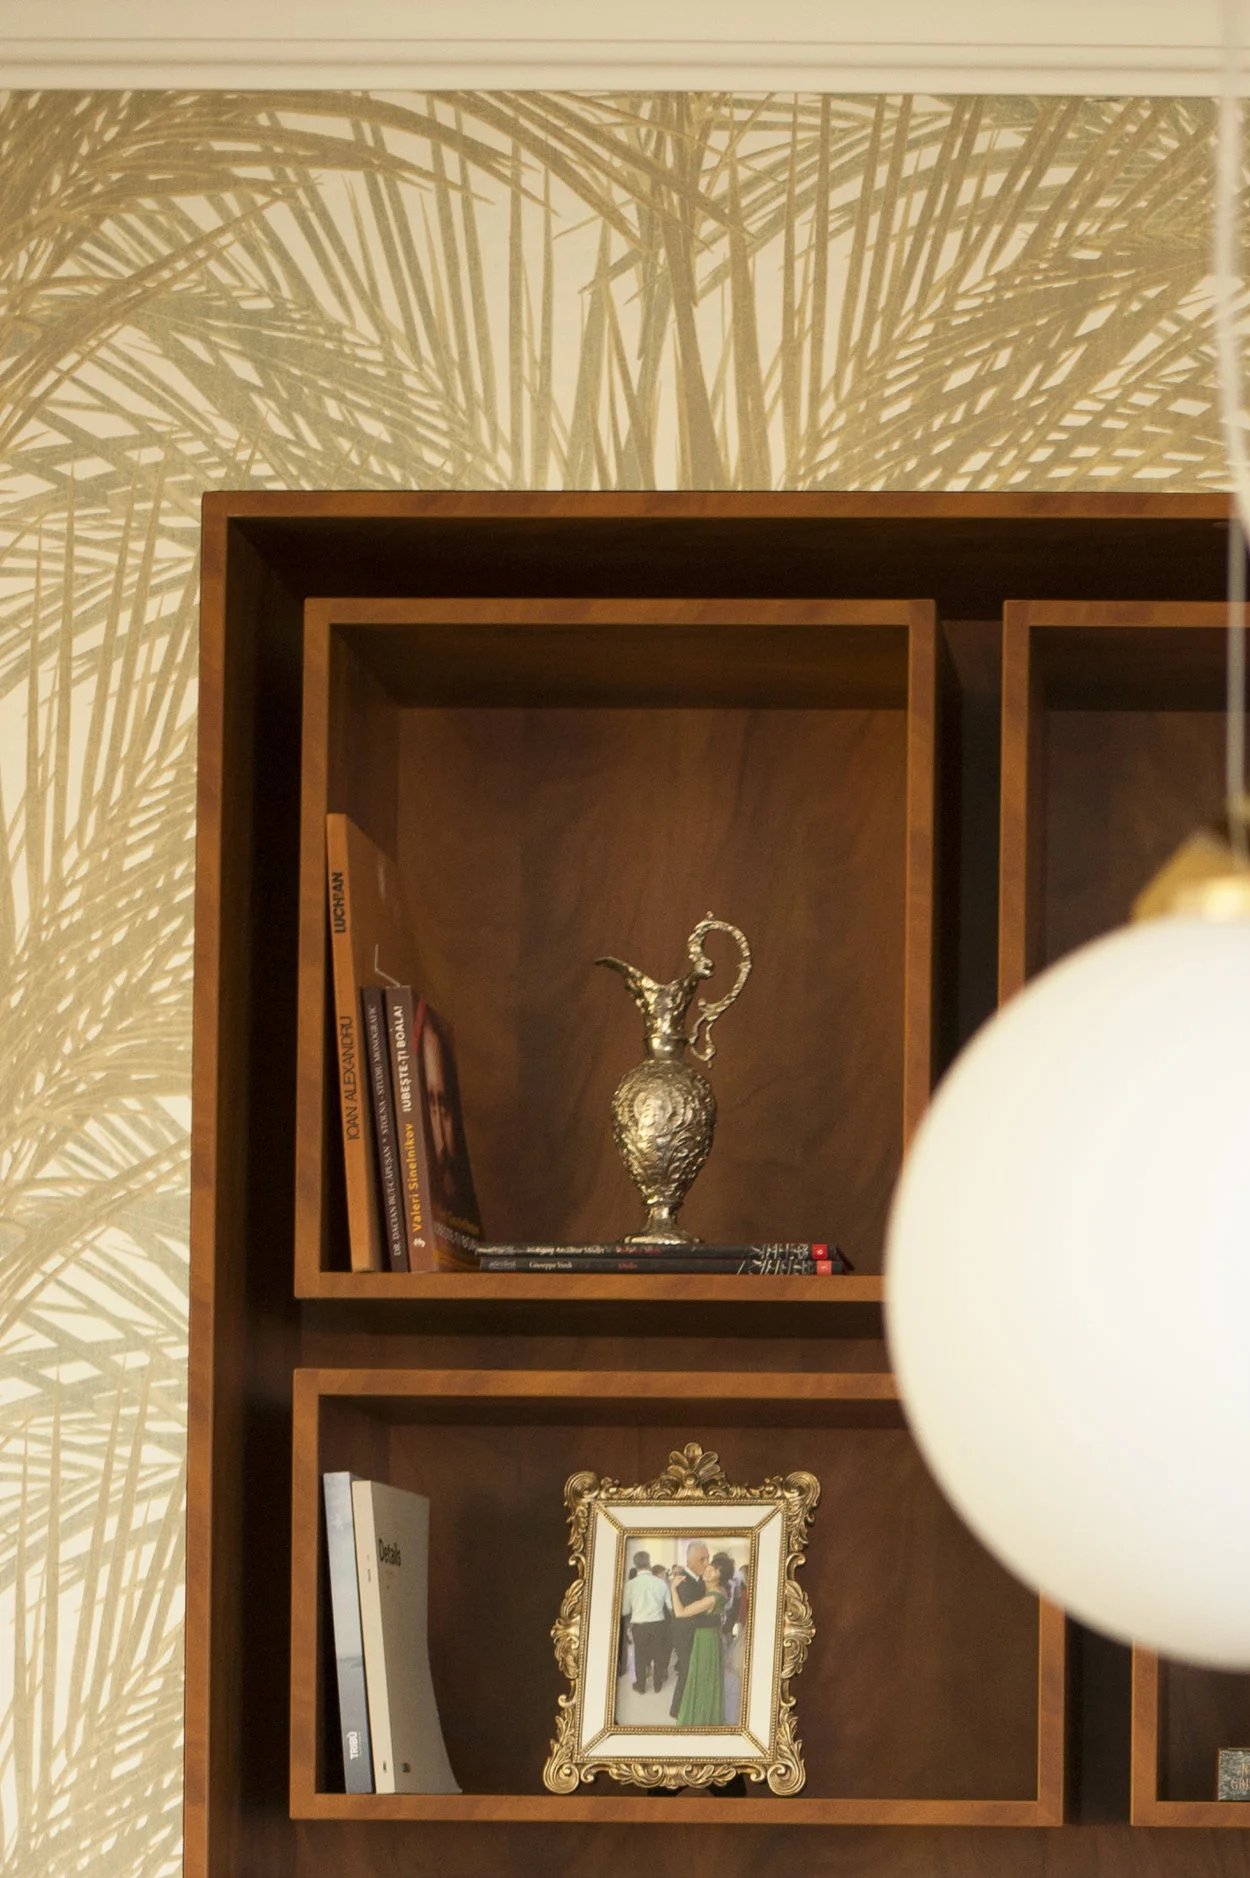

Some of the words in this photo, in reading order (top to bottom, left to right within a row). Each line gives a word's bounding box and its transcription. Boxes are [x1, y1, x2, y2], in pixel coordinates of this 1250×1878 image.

[332, 871, 346, 934] LUCHIAN
[368, 1004, 382, 1062] MONOGRAFIC
[339, 1015, 358, 1102] ALEXANDRU
[344, 1106, 360, 1141] IOAN
[404, 1122, 419, 1190] Sinelnikov
[390, 1207, 400, 1240] DACIAN
[409, 1194, 422, 1233] Valeri
[393, 1242, 401, 1256] DR.
[379, 1537, 401, 1566] Details
